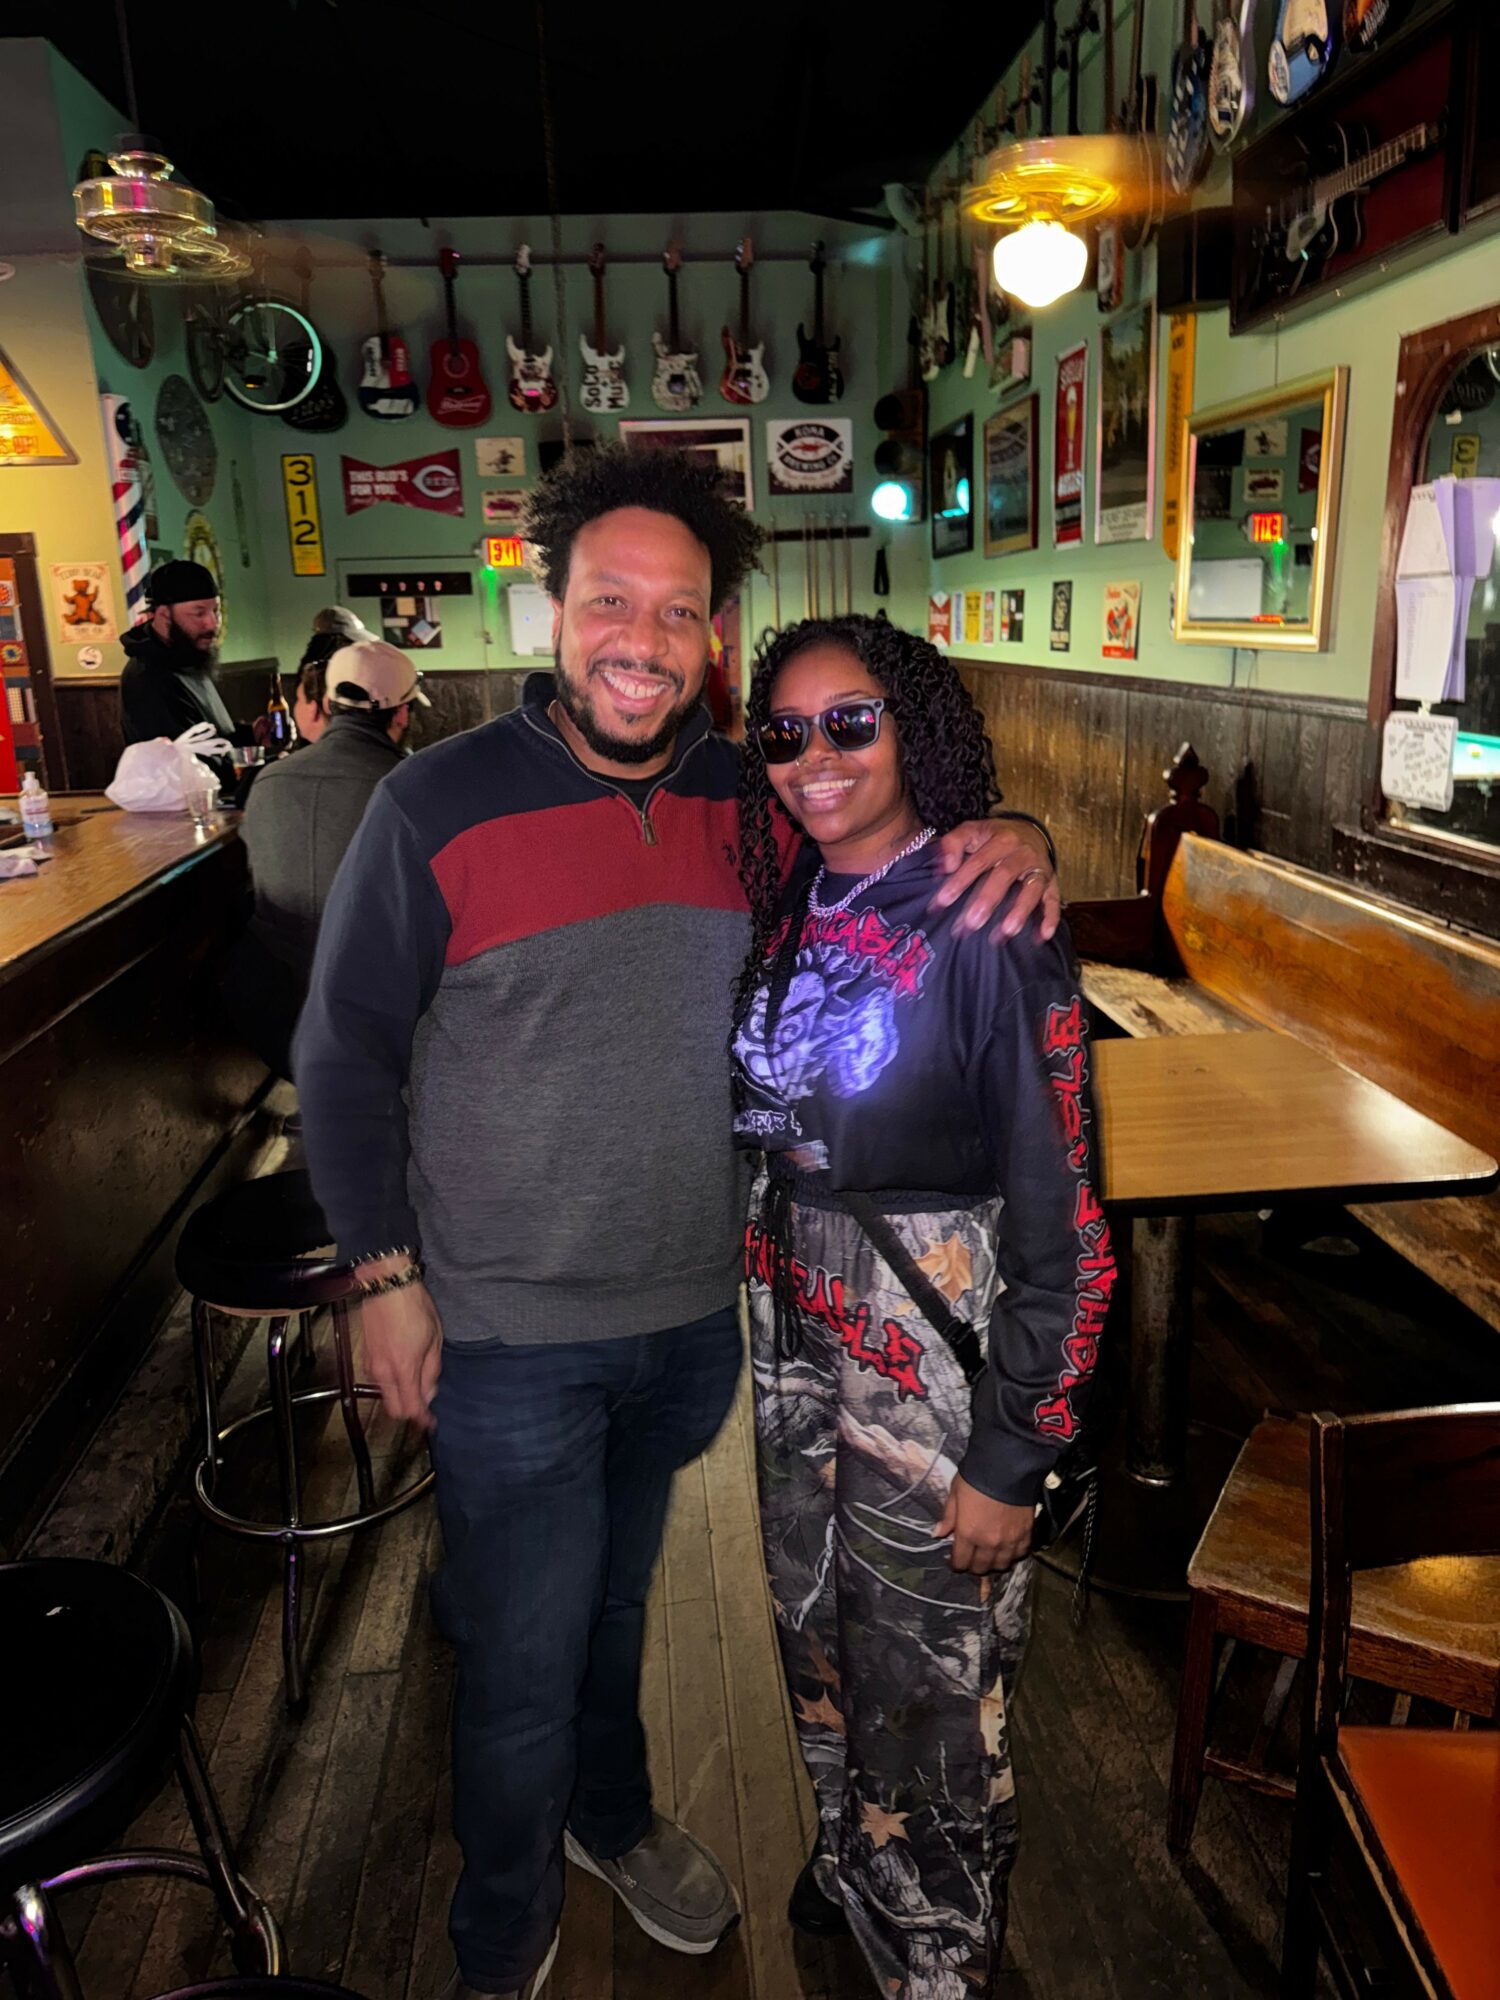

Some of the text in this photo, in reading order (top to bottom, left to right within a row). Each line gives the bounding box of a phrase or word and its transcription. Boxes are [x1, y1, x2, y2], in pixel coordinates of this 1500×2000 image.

[349, 470, 374, 482] THIS
[350, 484, 372, 496] FOR
[288, 460, 318, 546] 312
